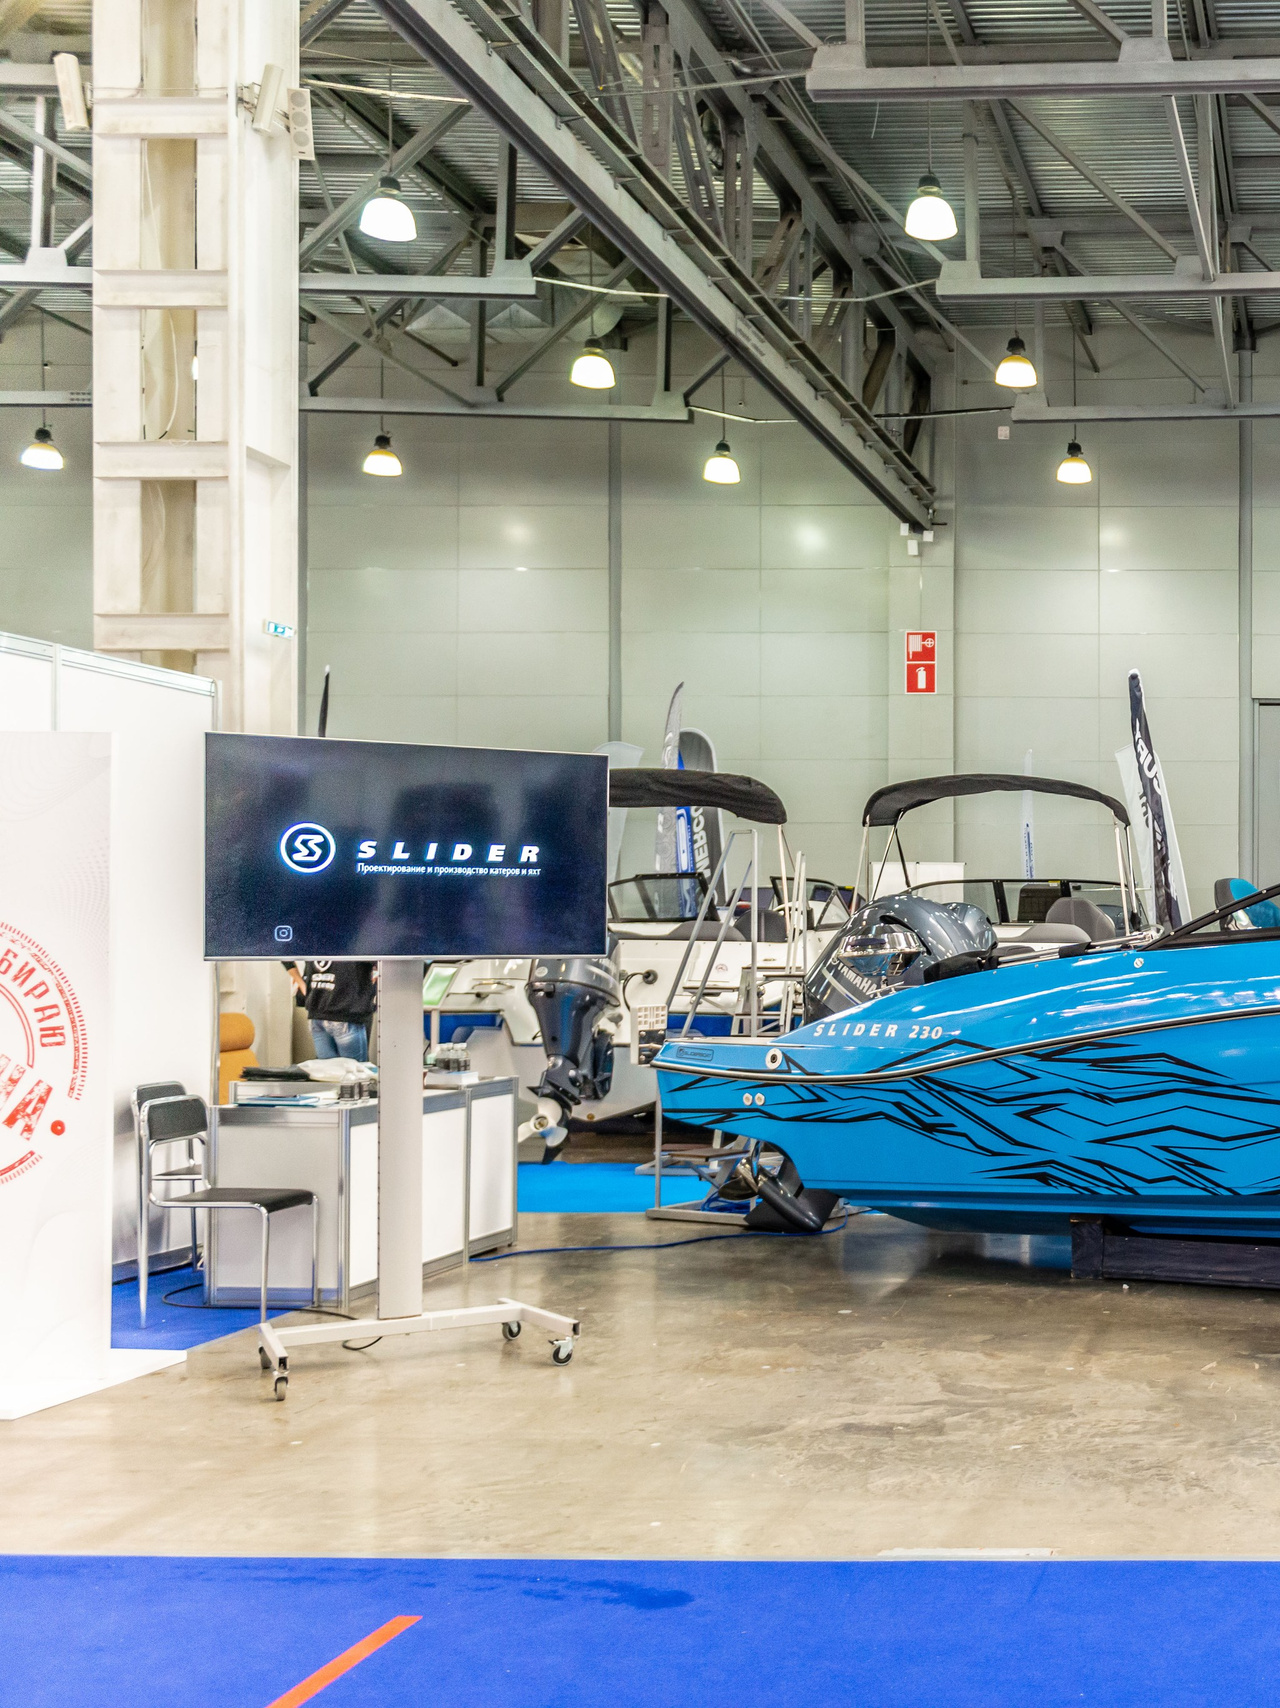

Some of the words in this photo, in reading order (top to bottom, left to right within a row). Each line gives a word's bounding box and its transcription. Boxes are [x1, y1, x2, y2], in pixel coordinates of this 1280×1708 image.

[357, 840, 541, 863] SLIDER
[357, 862, 426, 874] Проектирование
[434, 866, 488, 876] производство
[490, 868, 520, 877] катеров
[521, 868, 527, 876] и
[528, 868, 541, 876] яхт
[813, 1023, 898, 1037] SLIDER
[909, 1025, 943, 1039] 230
